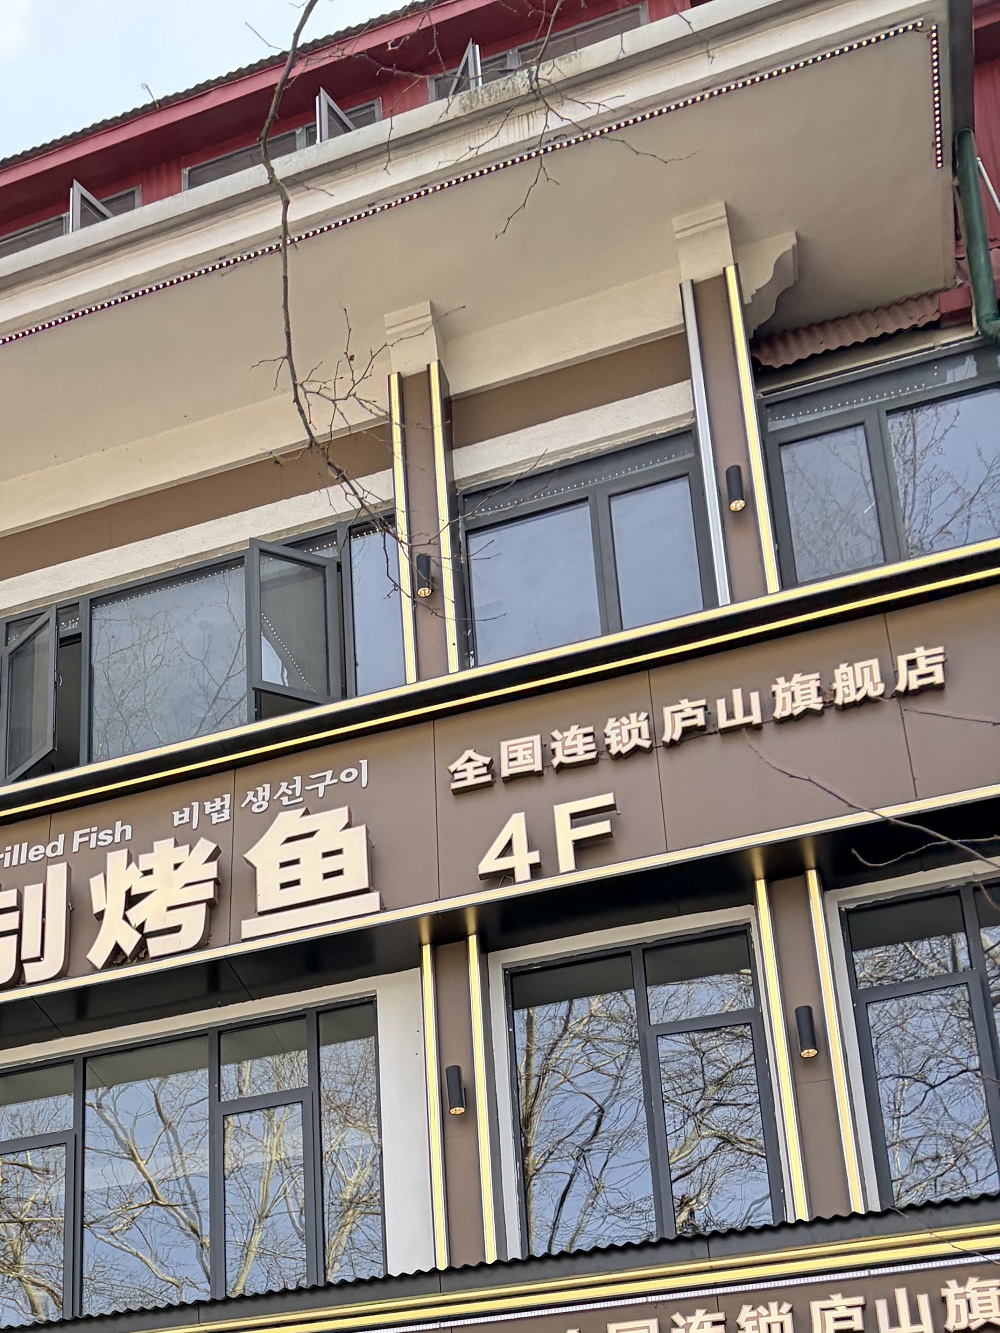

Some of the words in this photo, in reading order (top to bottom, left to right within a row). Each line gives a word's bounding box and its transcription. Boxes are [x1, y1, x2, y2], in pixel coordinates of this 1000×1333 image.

[447, 645, 947, 794] 全国连锁庐山旗舰店
[172, 792, 232, 831] 비법
[240, 758, 369, 815] 생선구이
[72, 820, 133, 855] Fish
[477, 792, 618, 884] 4F
